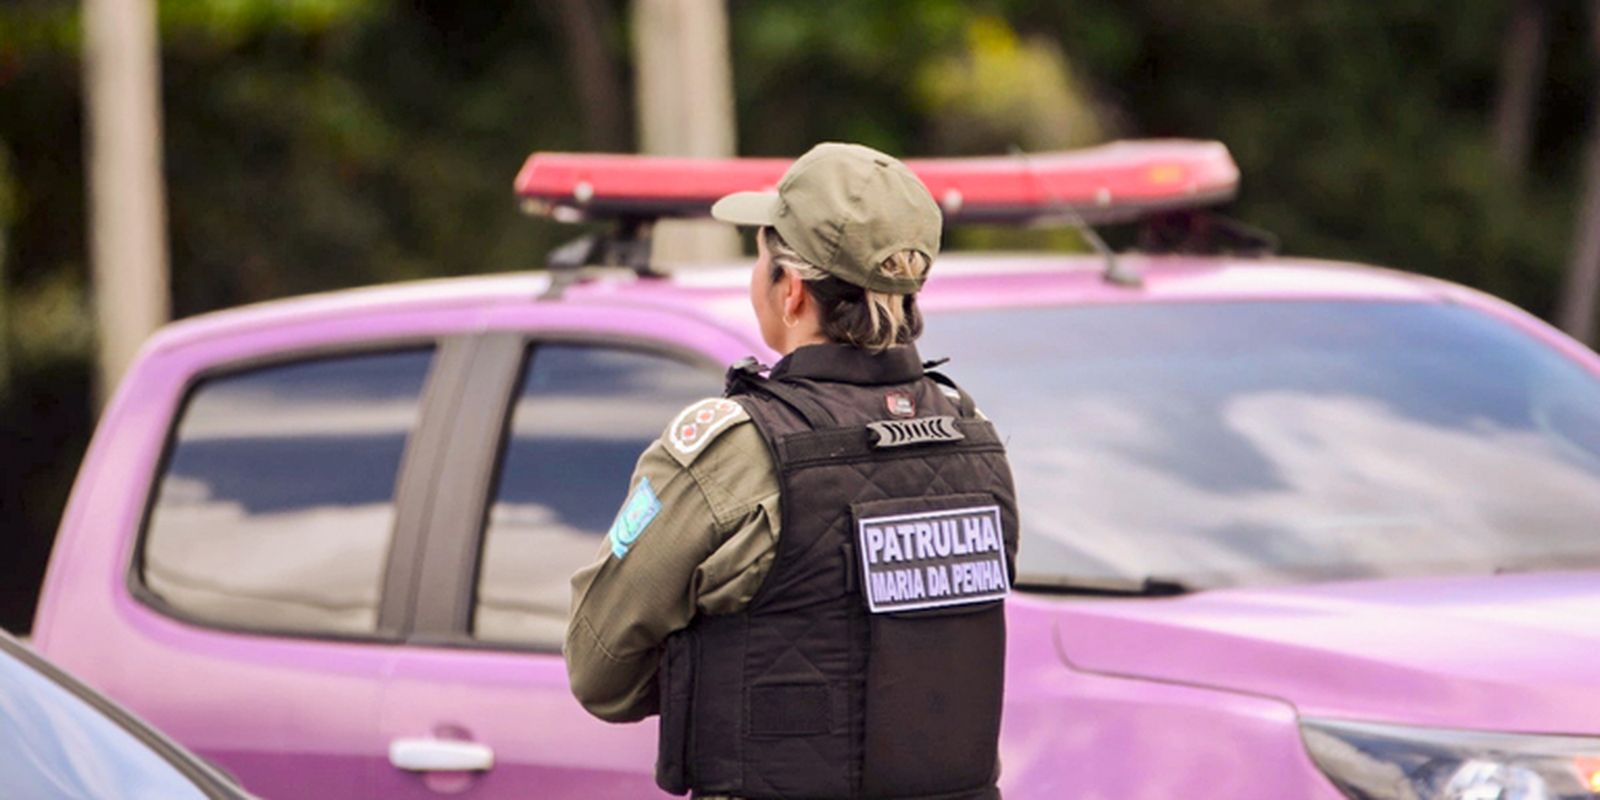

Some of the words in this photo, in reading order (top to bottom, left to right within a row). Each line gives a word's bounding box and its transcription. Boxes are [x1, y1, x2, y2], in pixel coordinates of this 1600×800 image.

[866, 516, 998, 563] PATRULHA
[871, 568, 925, 602] MARIA
[926, 565, 950, 597] DA
[952, 560, 1004, 594] PENHA
